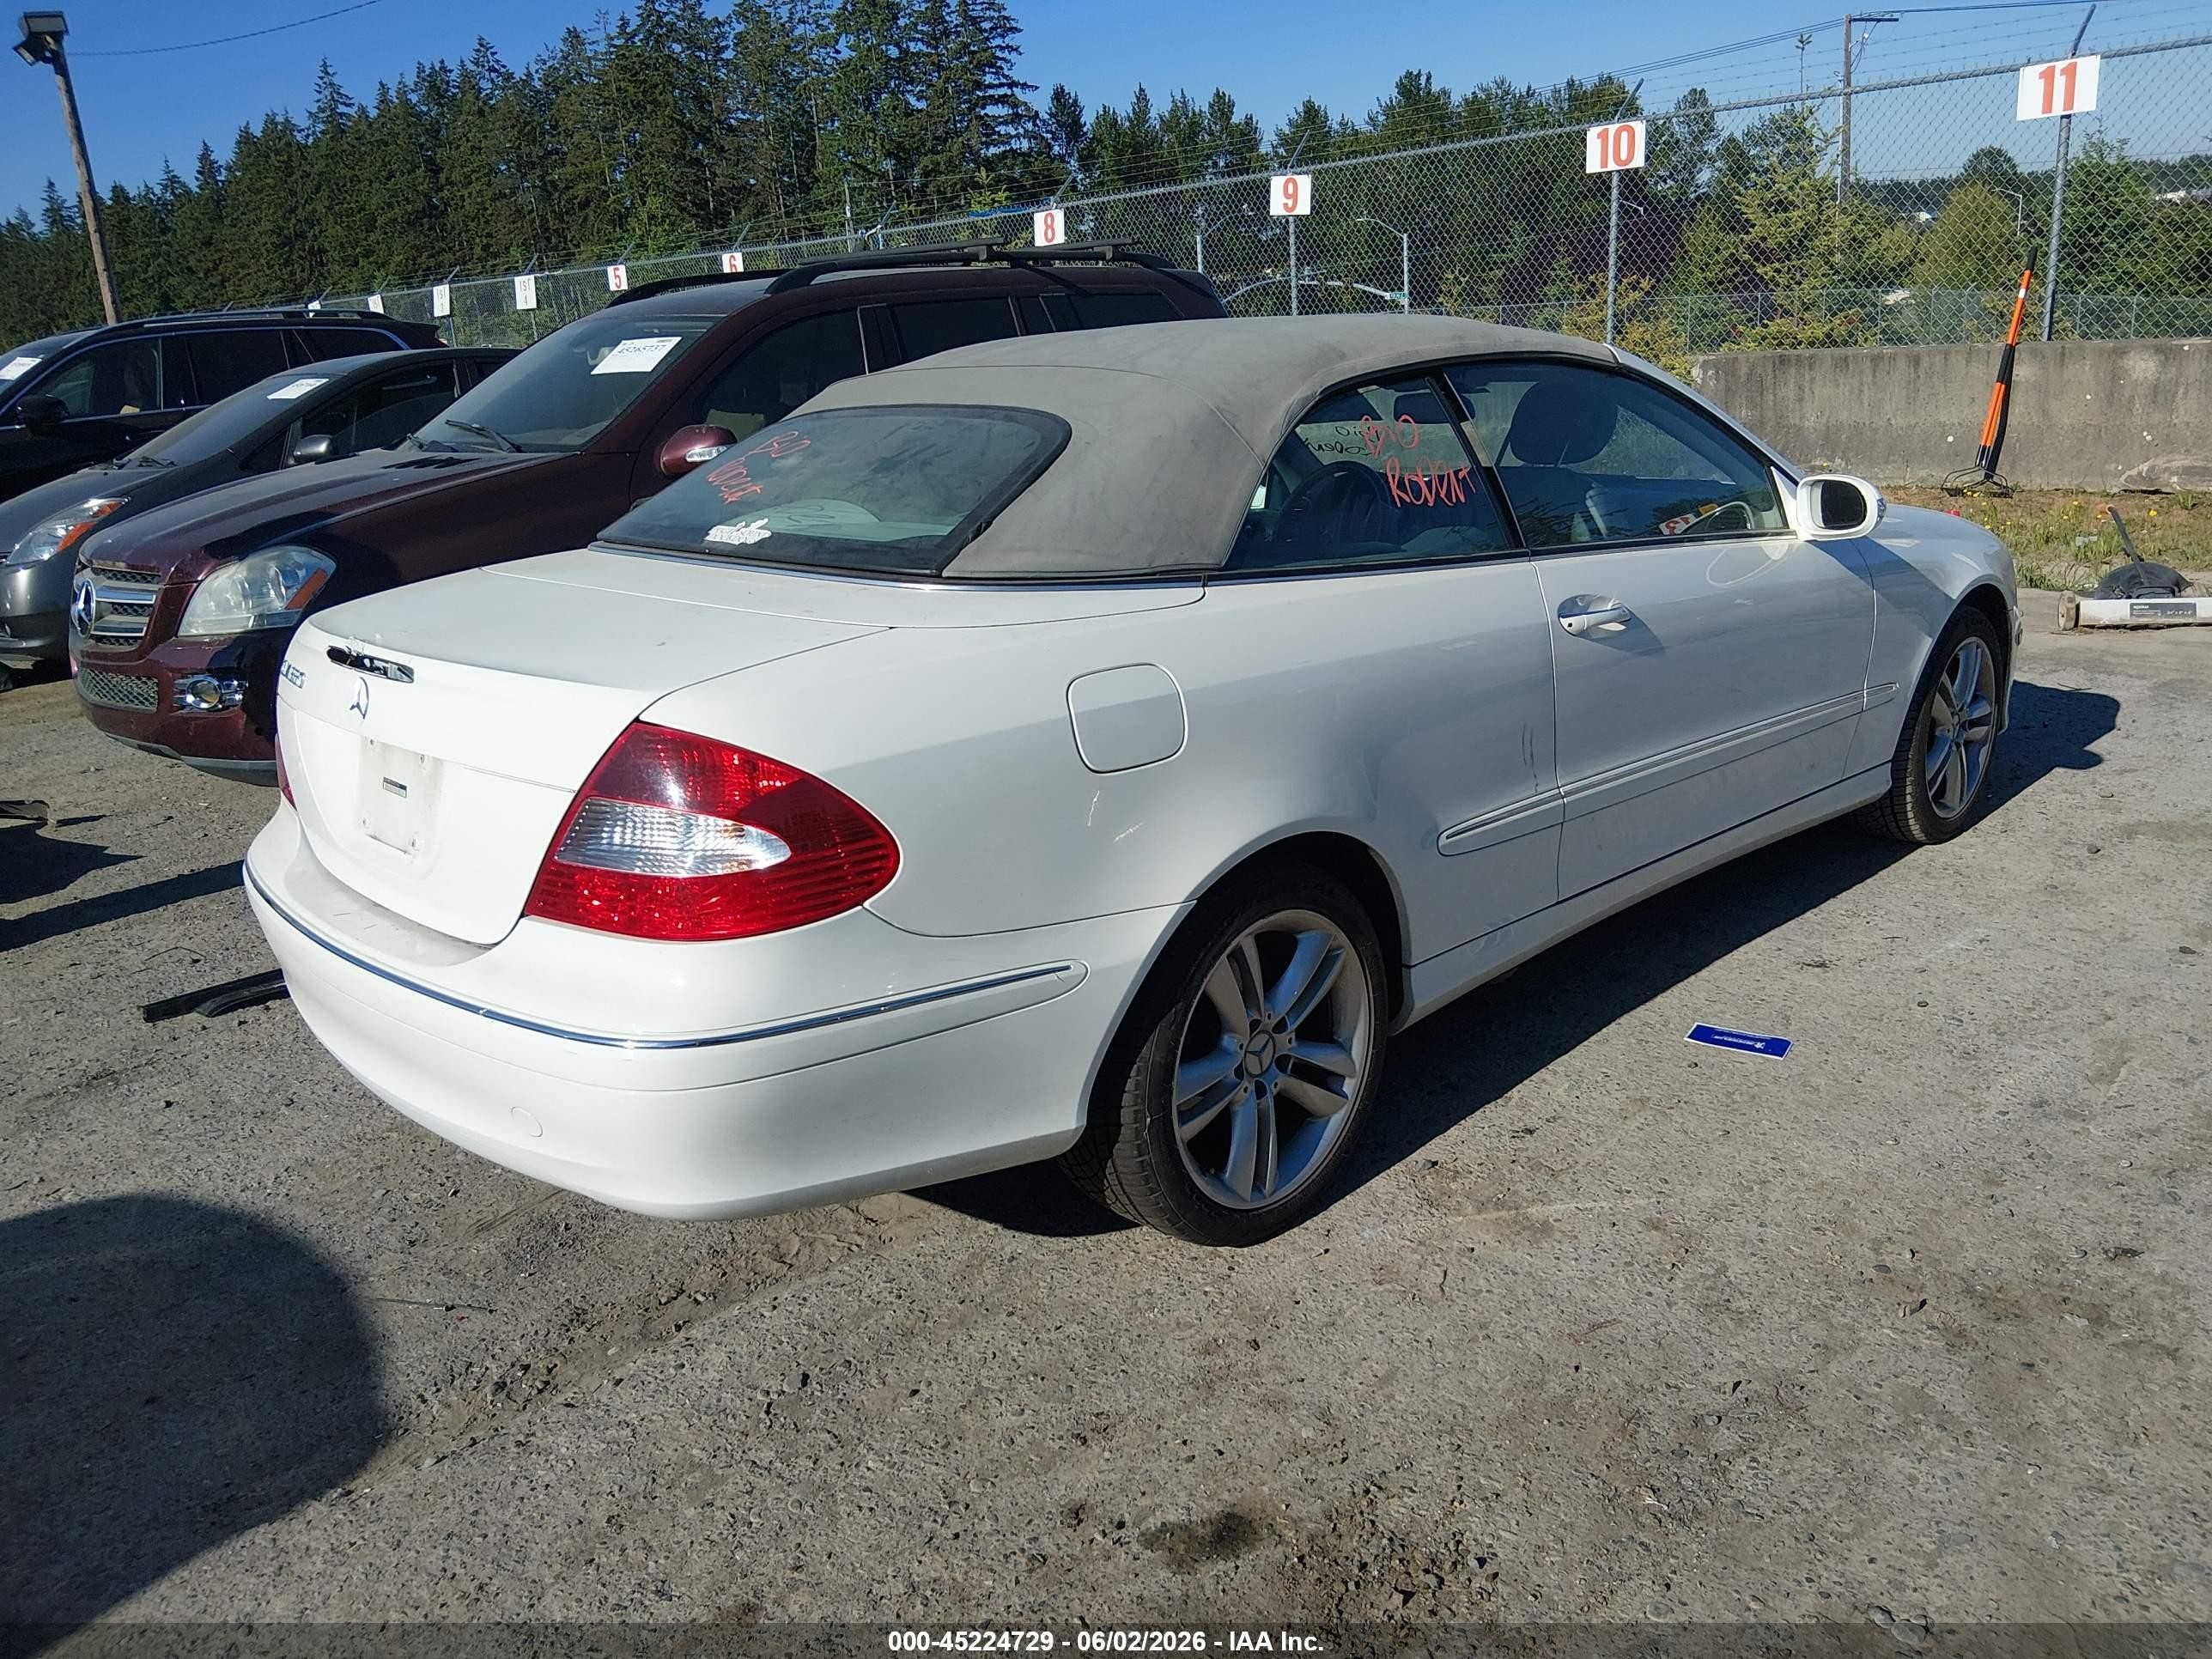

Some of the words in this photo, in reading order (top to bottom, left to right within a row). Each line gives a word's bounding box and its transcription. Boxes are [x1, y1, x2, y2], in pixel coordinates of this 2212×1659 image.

[2038, 62, 2077, 114] 11
[1597, 125, 1635, 169] 10
[1283, 177, 1298, 213] 9
[1043, 212, 1055, 243] 8
[613, 267, 622, 289] 5
[728, 254, 738, 273] 6
